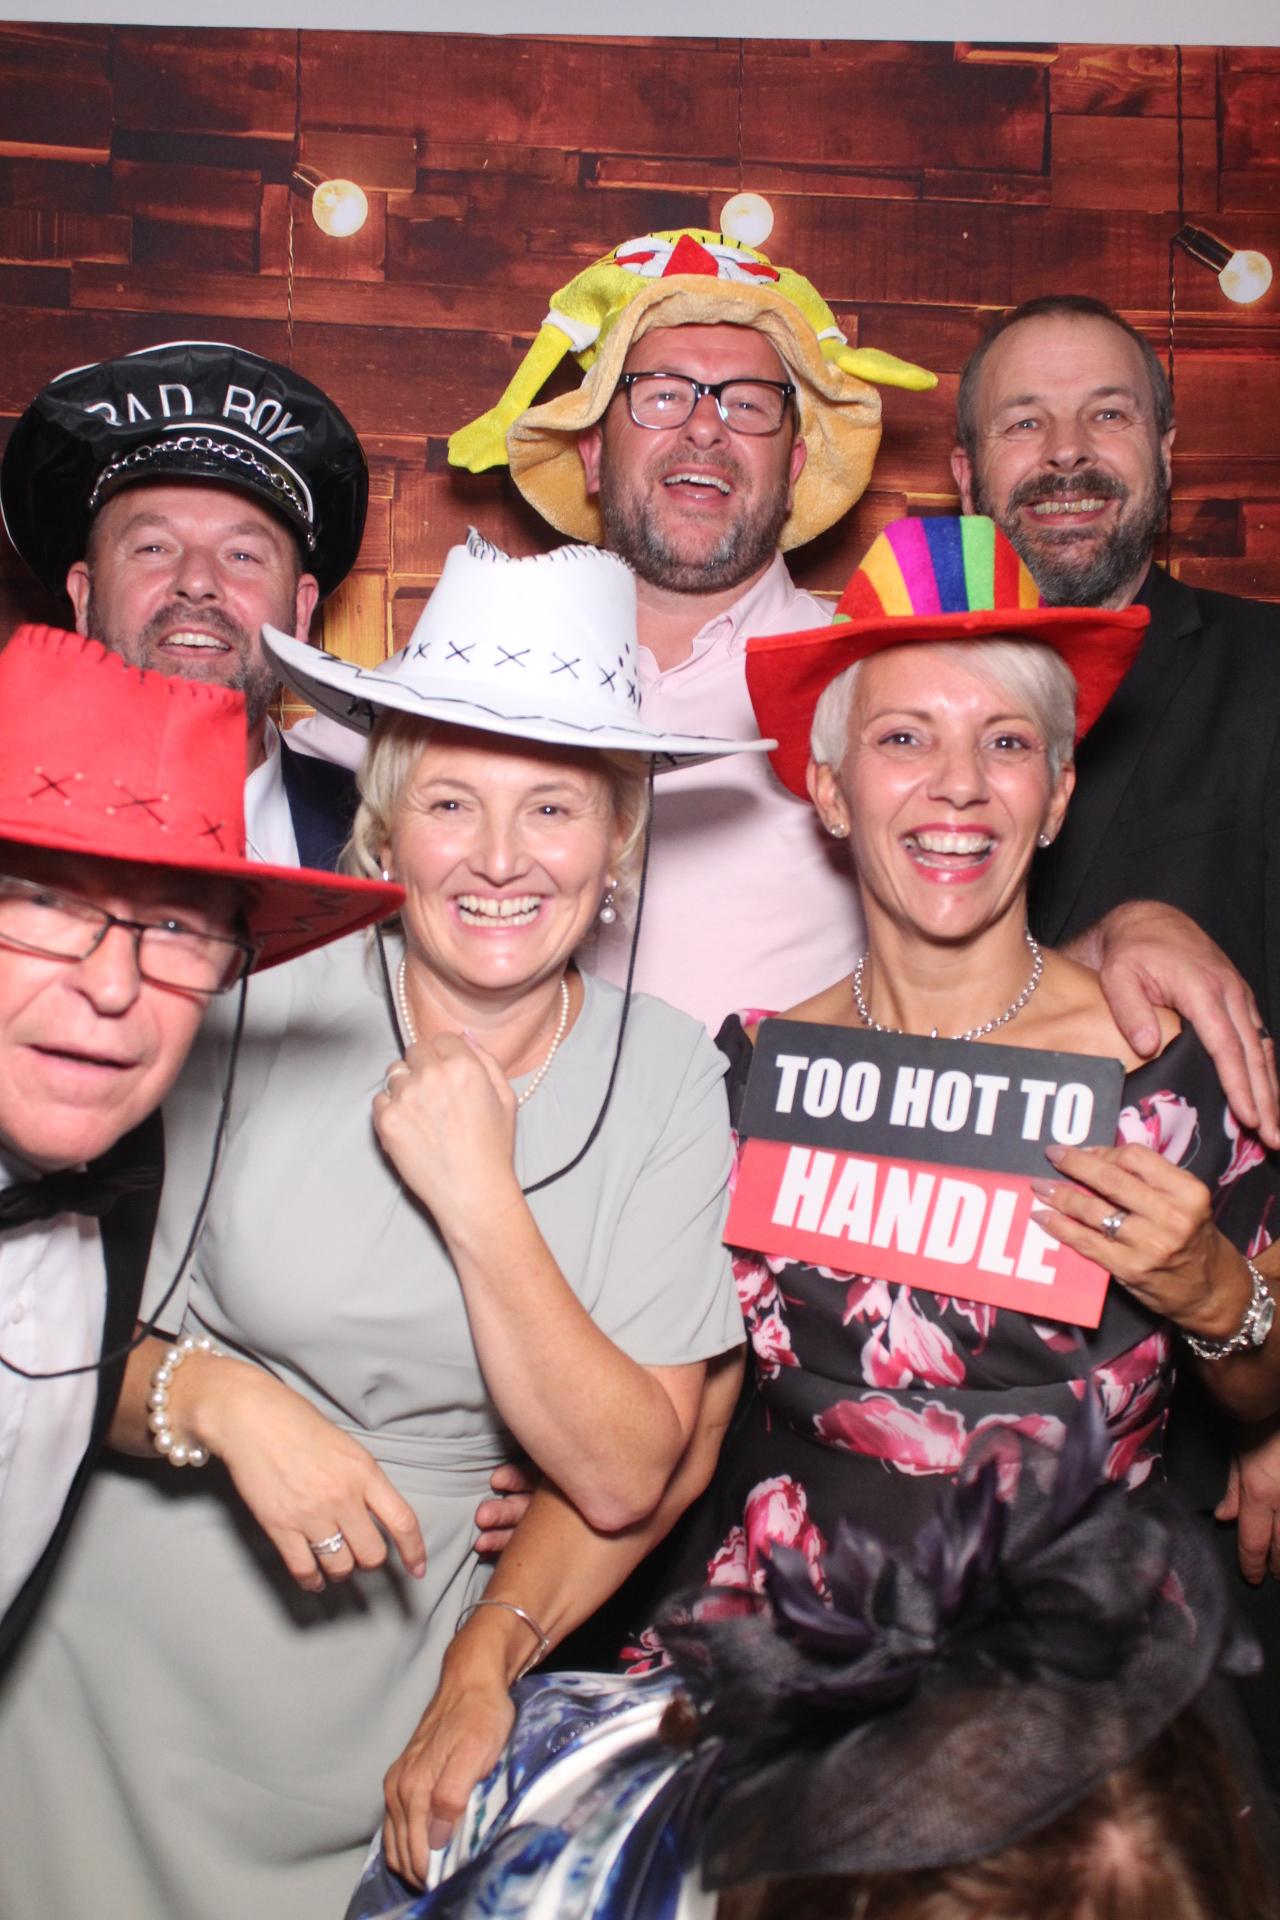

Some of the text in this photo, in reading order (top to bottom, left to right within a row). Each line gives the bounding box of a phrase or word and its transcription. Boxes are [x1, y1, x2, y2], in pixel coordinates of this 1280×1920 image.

[222, 384, 305, 442] BOY
[775, 1054, 1095, 1146] TOO HOT TO
[771, 1146, 1061, 1285] HANDLE
